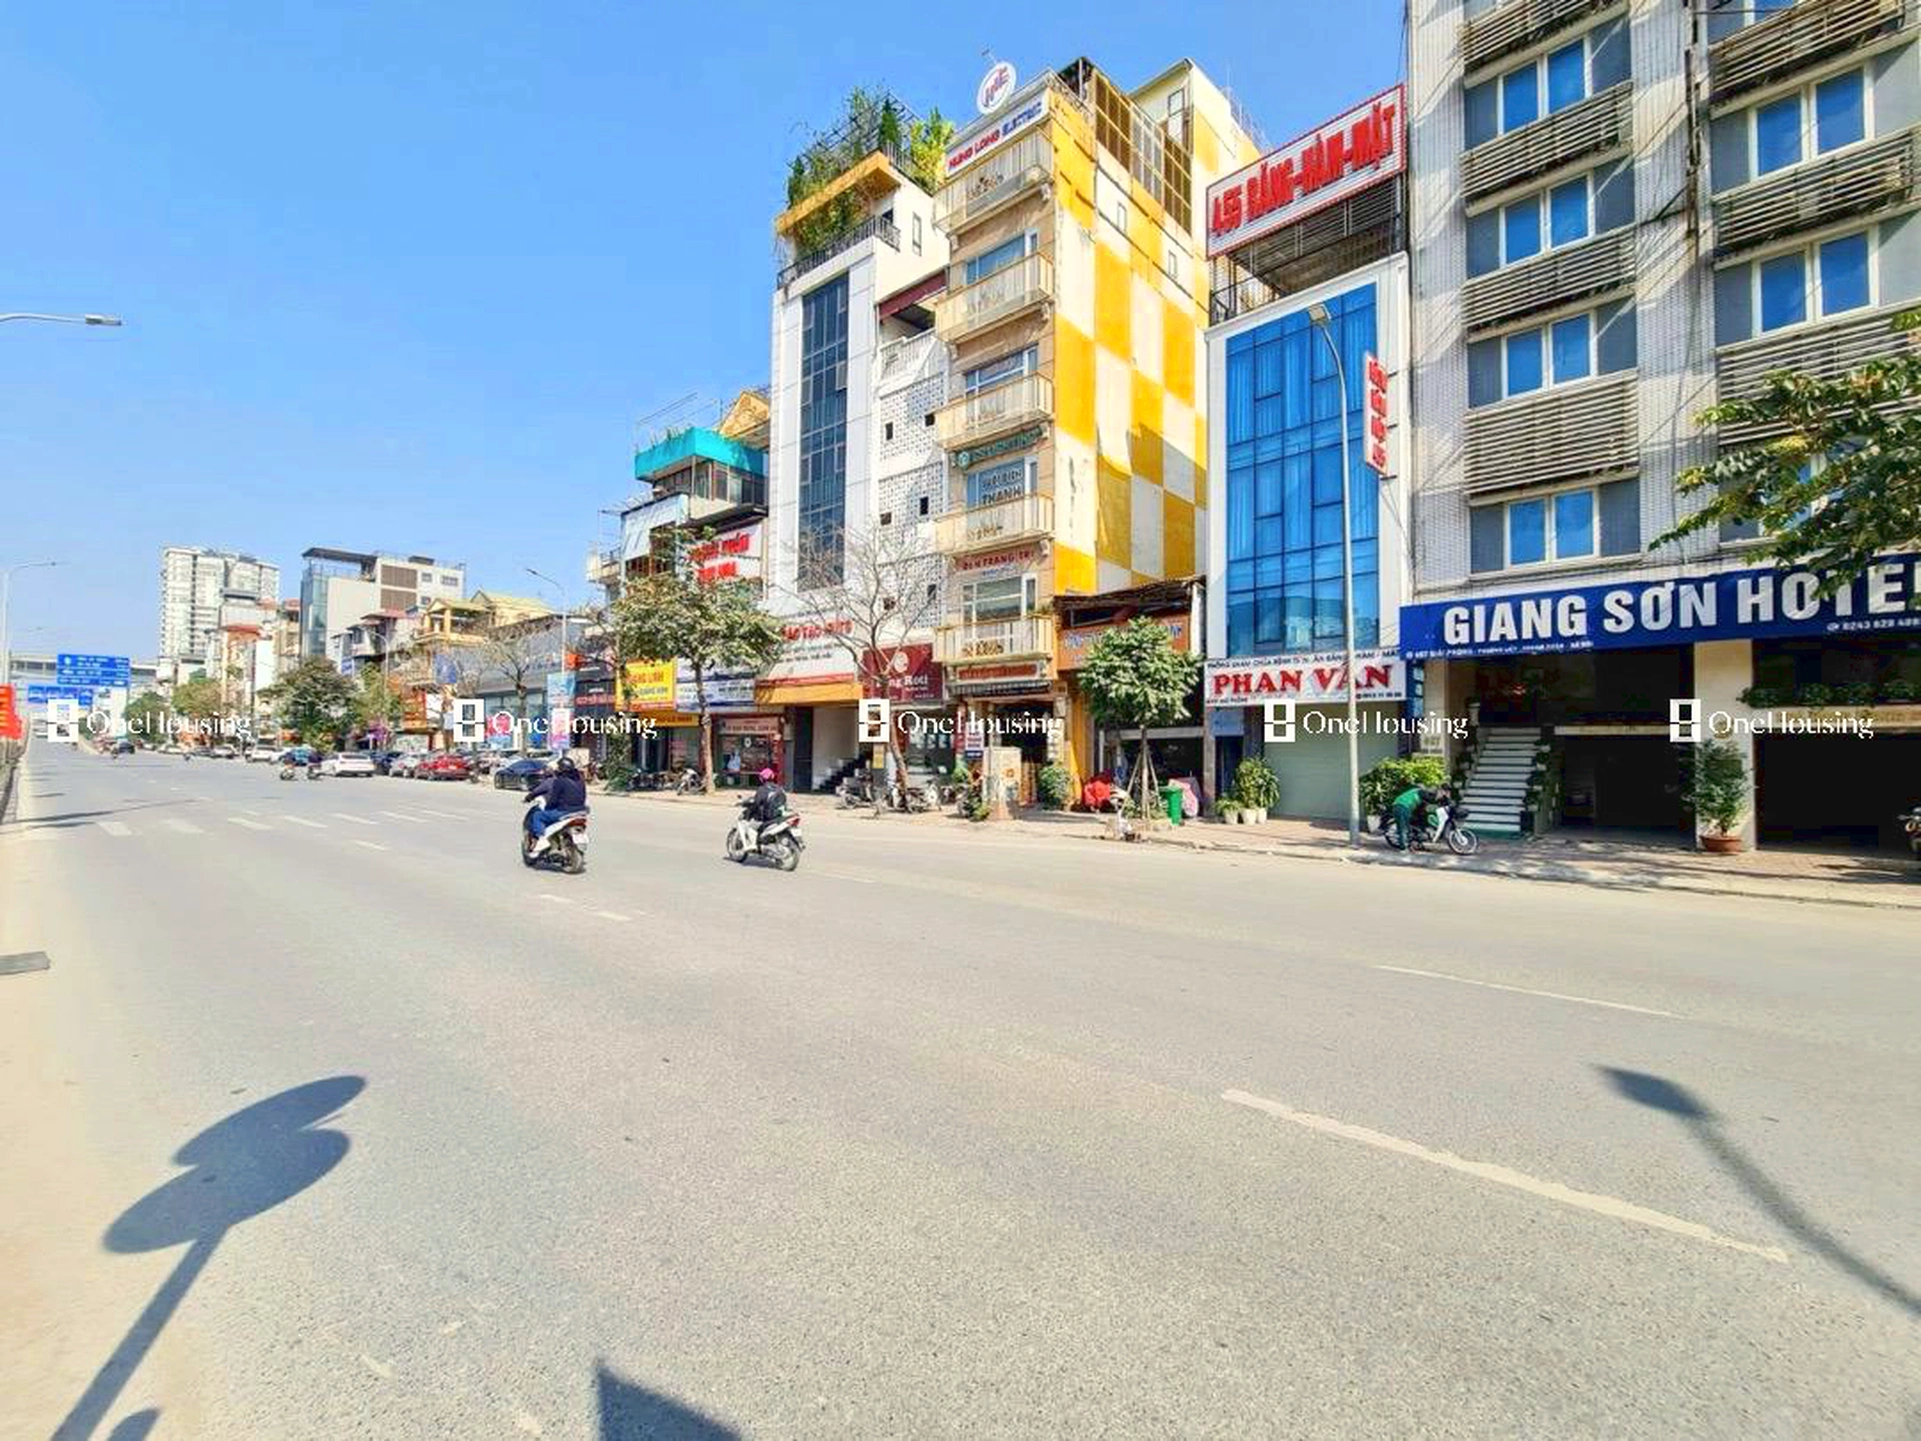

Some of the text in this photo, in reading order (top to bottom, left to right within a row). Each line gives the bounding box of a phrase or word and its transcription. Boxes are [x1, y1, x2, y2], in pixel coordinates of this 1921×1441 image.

[1443, 562, 1921, 646] GIANG SƠN HOTE
[1213, 669, 1303, 695] PHAN
